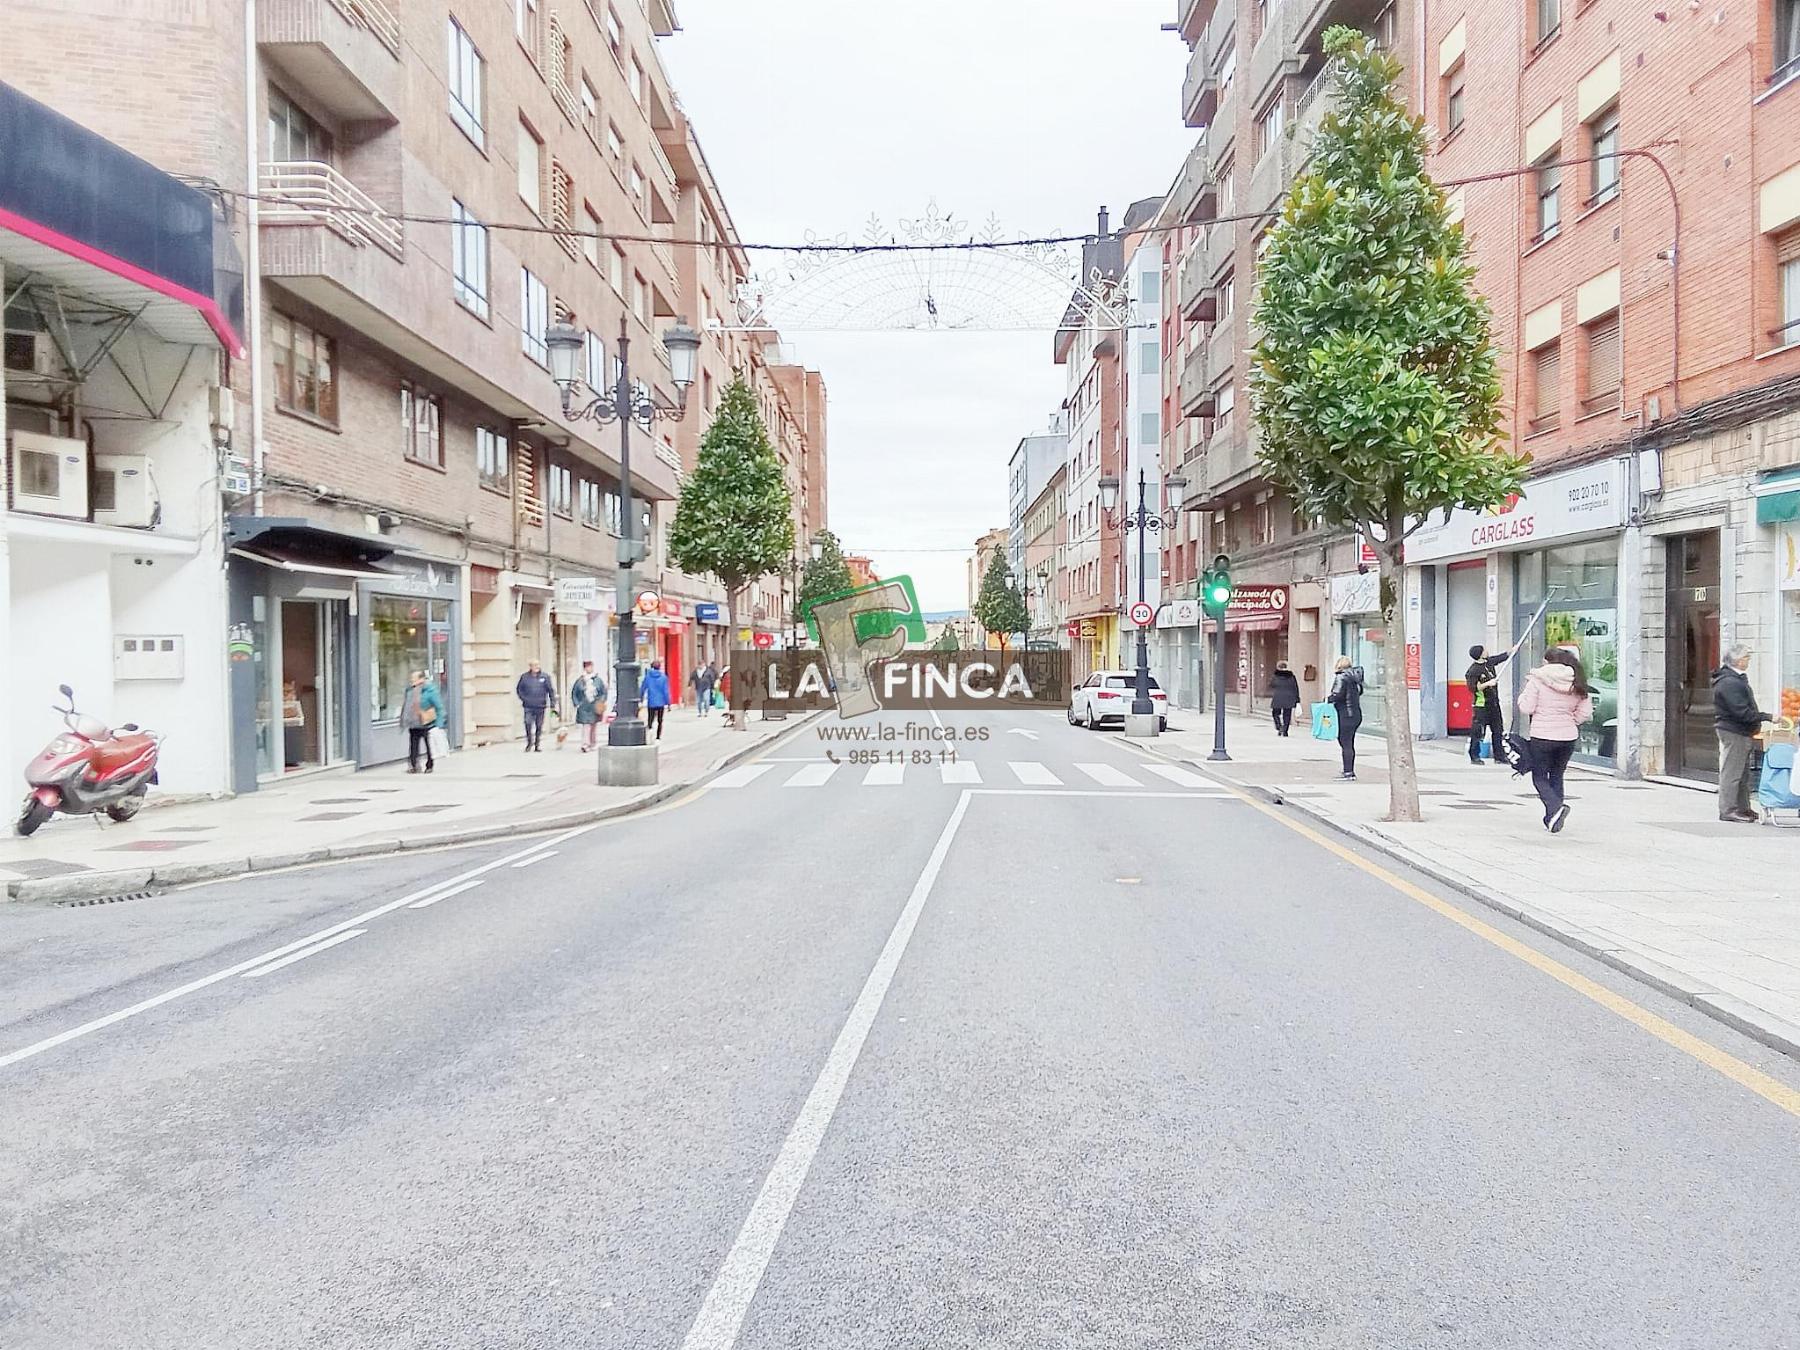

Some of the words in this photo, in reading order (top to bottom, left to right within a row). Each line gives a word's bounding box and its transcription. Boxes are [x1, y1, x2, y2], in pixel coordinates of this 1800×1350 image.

[1591, 483, 1599, 497] 70
[1601, 480, 1609, 494] 10
[1472, 516, 1535, 545] CARGLASS
[1135, 609, 1148, 618] 30
